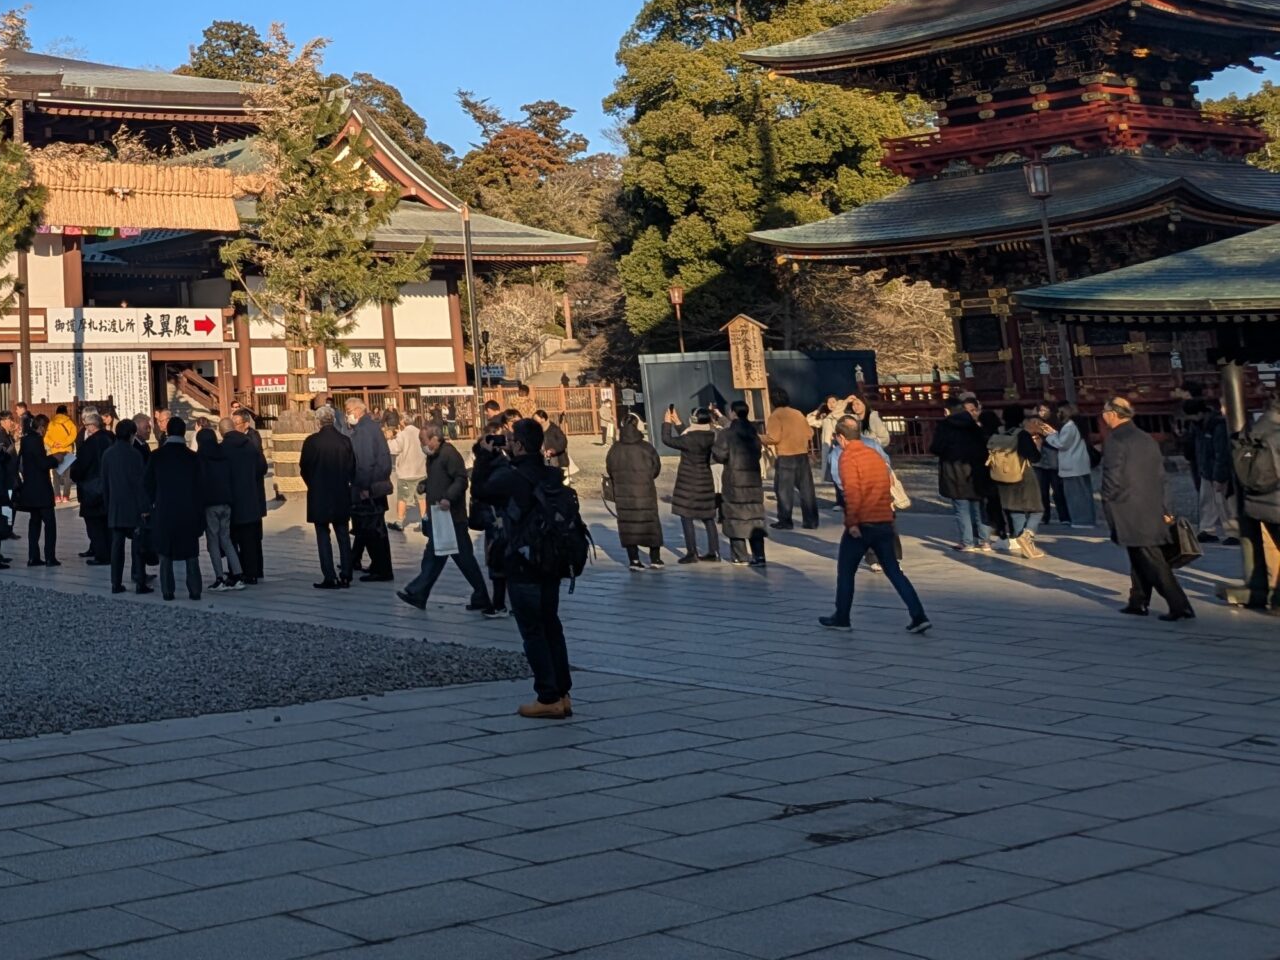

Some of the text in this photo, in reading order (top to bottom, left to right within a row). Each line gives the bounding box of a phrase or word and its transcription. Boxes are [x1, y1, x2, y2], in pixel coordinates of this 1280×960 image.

[54, 318, 136, 334] 御護摩札お渡し所
[142, 313, 191, 338] 東翼殿
[332, 352, 382, 369] 東翼殿
